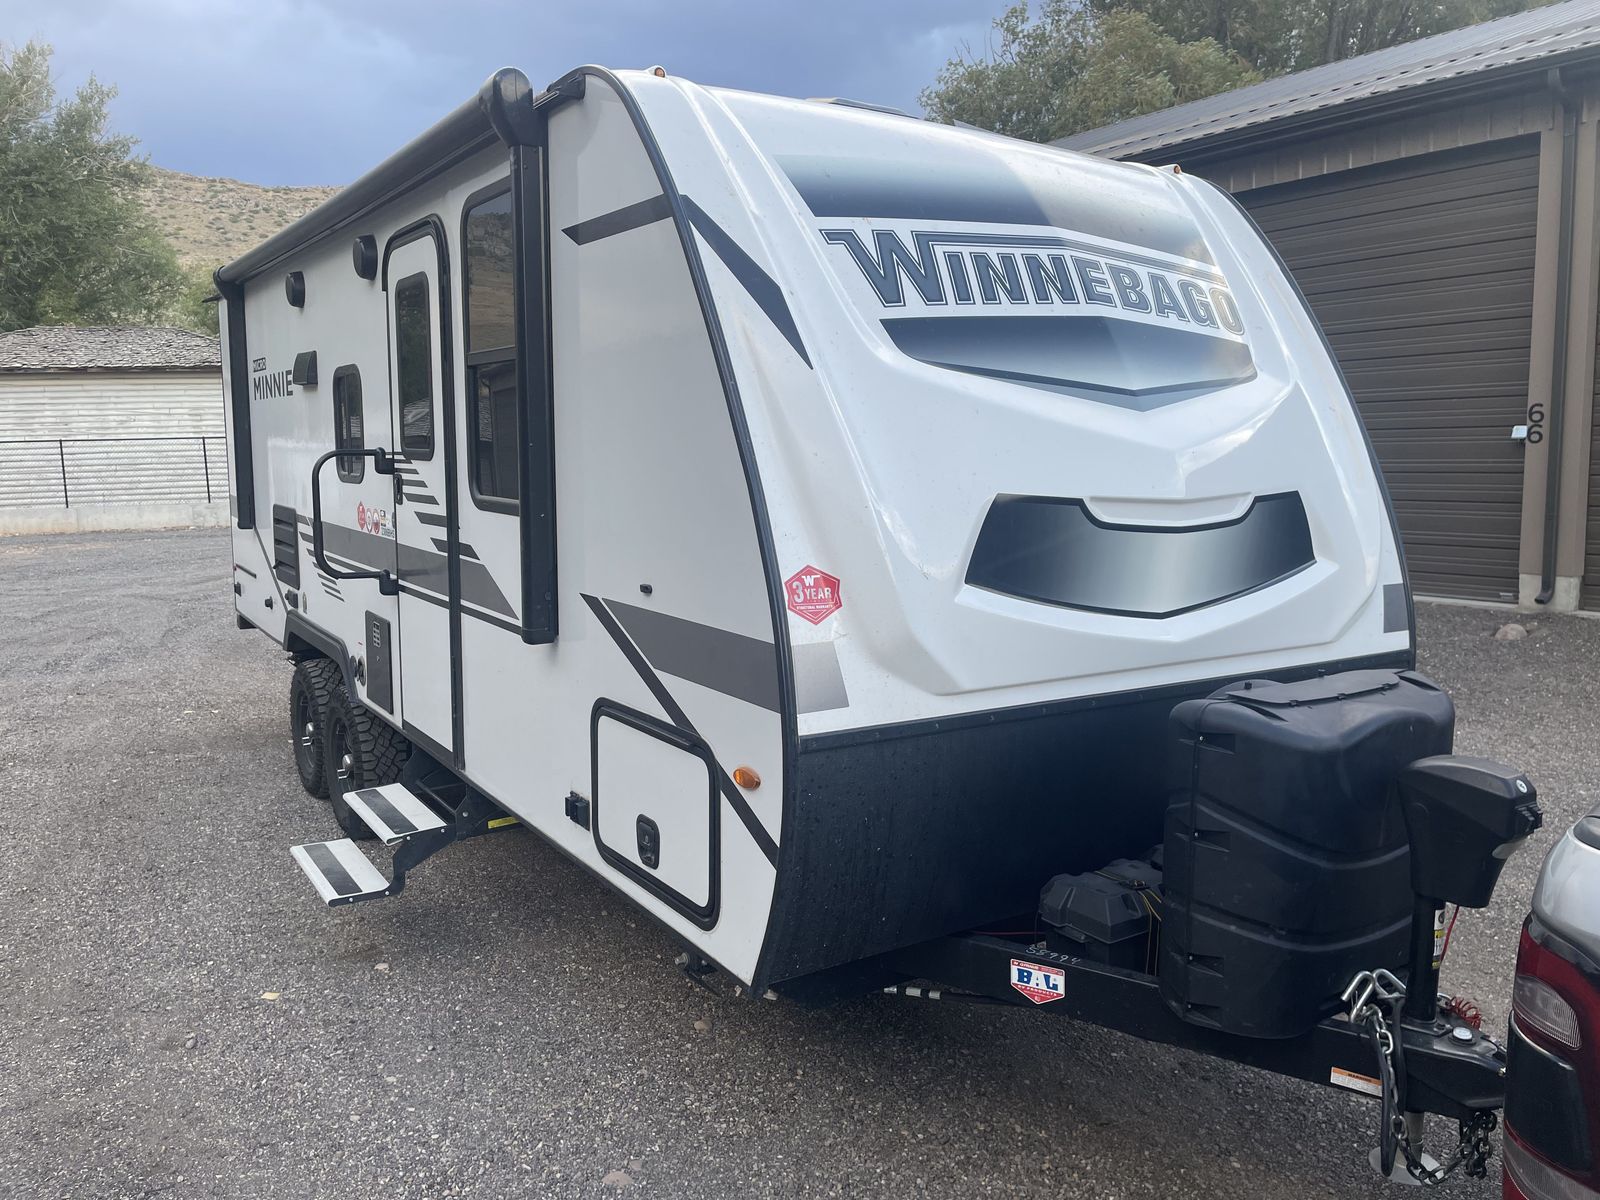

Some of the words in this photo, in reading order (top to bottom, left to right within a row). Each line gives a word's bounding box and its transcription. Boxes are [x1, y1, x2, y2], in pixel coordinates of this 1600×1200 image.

[819, 229, 1246, 335] WINNEBAGO
[253, 370, 294, 401] MINNIE
[792, 580, 805, 603] 3
[804, 587, 832, 600] YEAR
